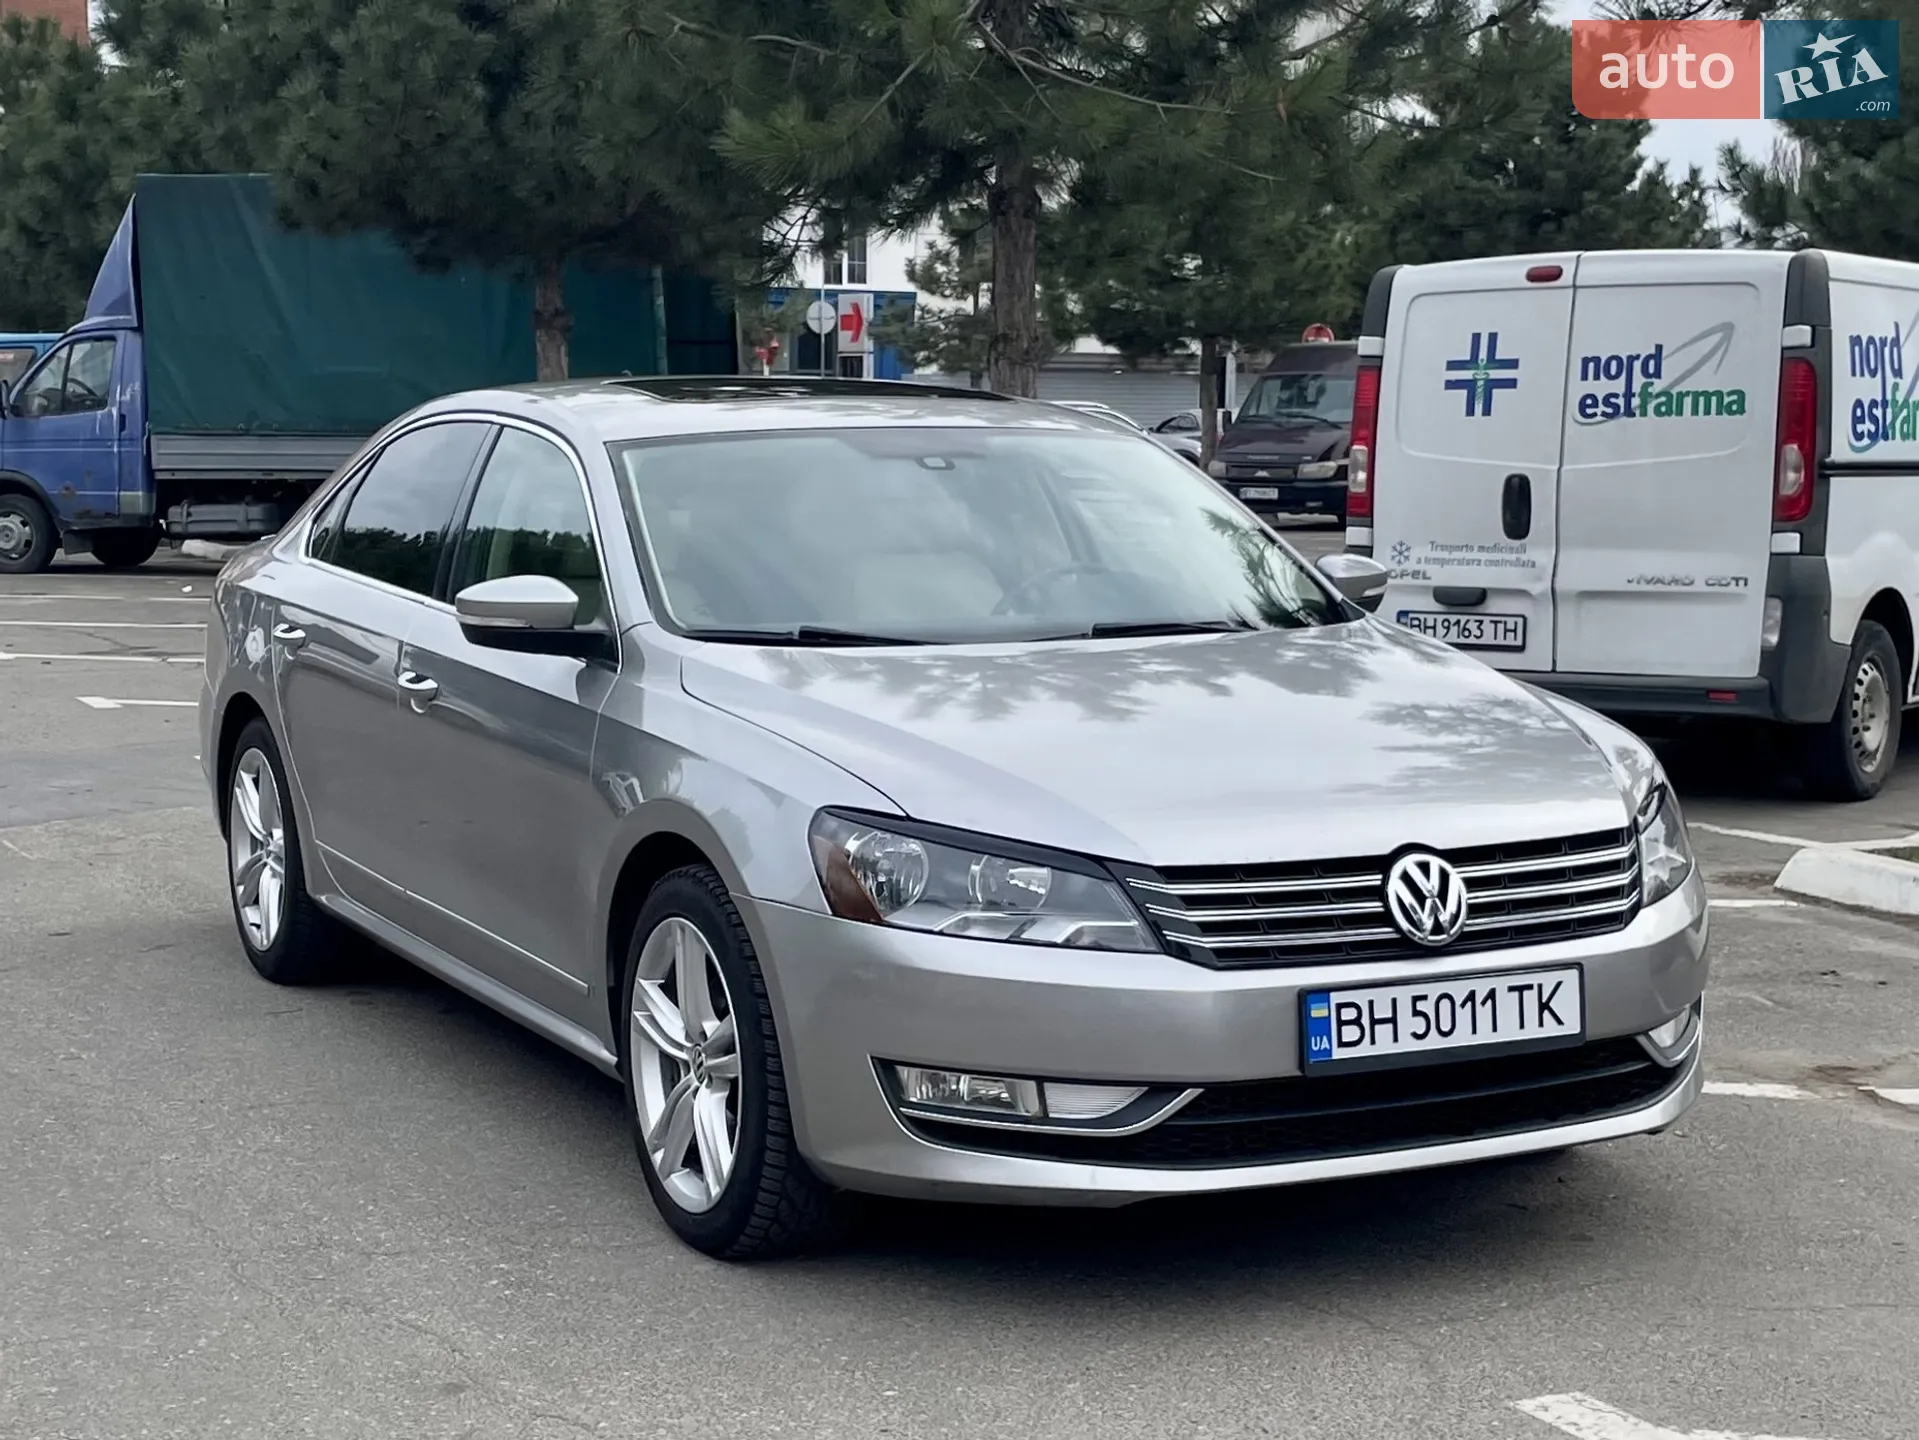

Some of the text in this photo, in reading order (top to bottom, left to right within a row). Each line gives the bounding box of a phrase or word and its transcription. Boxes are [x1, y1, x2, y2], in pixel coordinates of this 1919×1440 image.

[1580, 344, 1664, 382] nord
[1849, 321, 1904, 380] nord
[1388, 569, 1432, 581] OPEL
[1441, 618, 1485, 639] 9163
[1489, 620, 1519, 642] TH
[1335, 980, 1565, 1049] BH 5011 TK
[1311, 1036, 1330, 1051] UA
